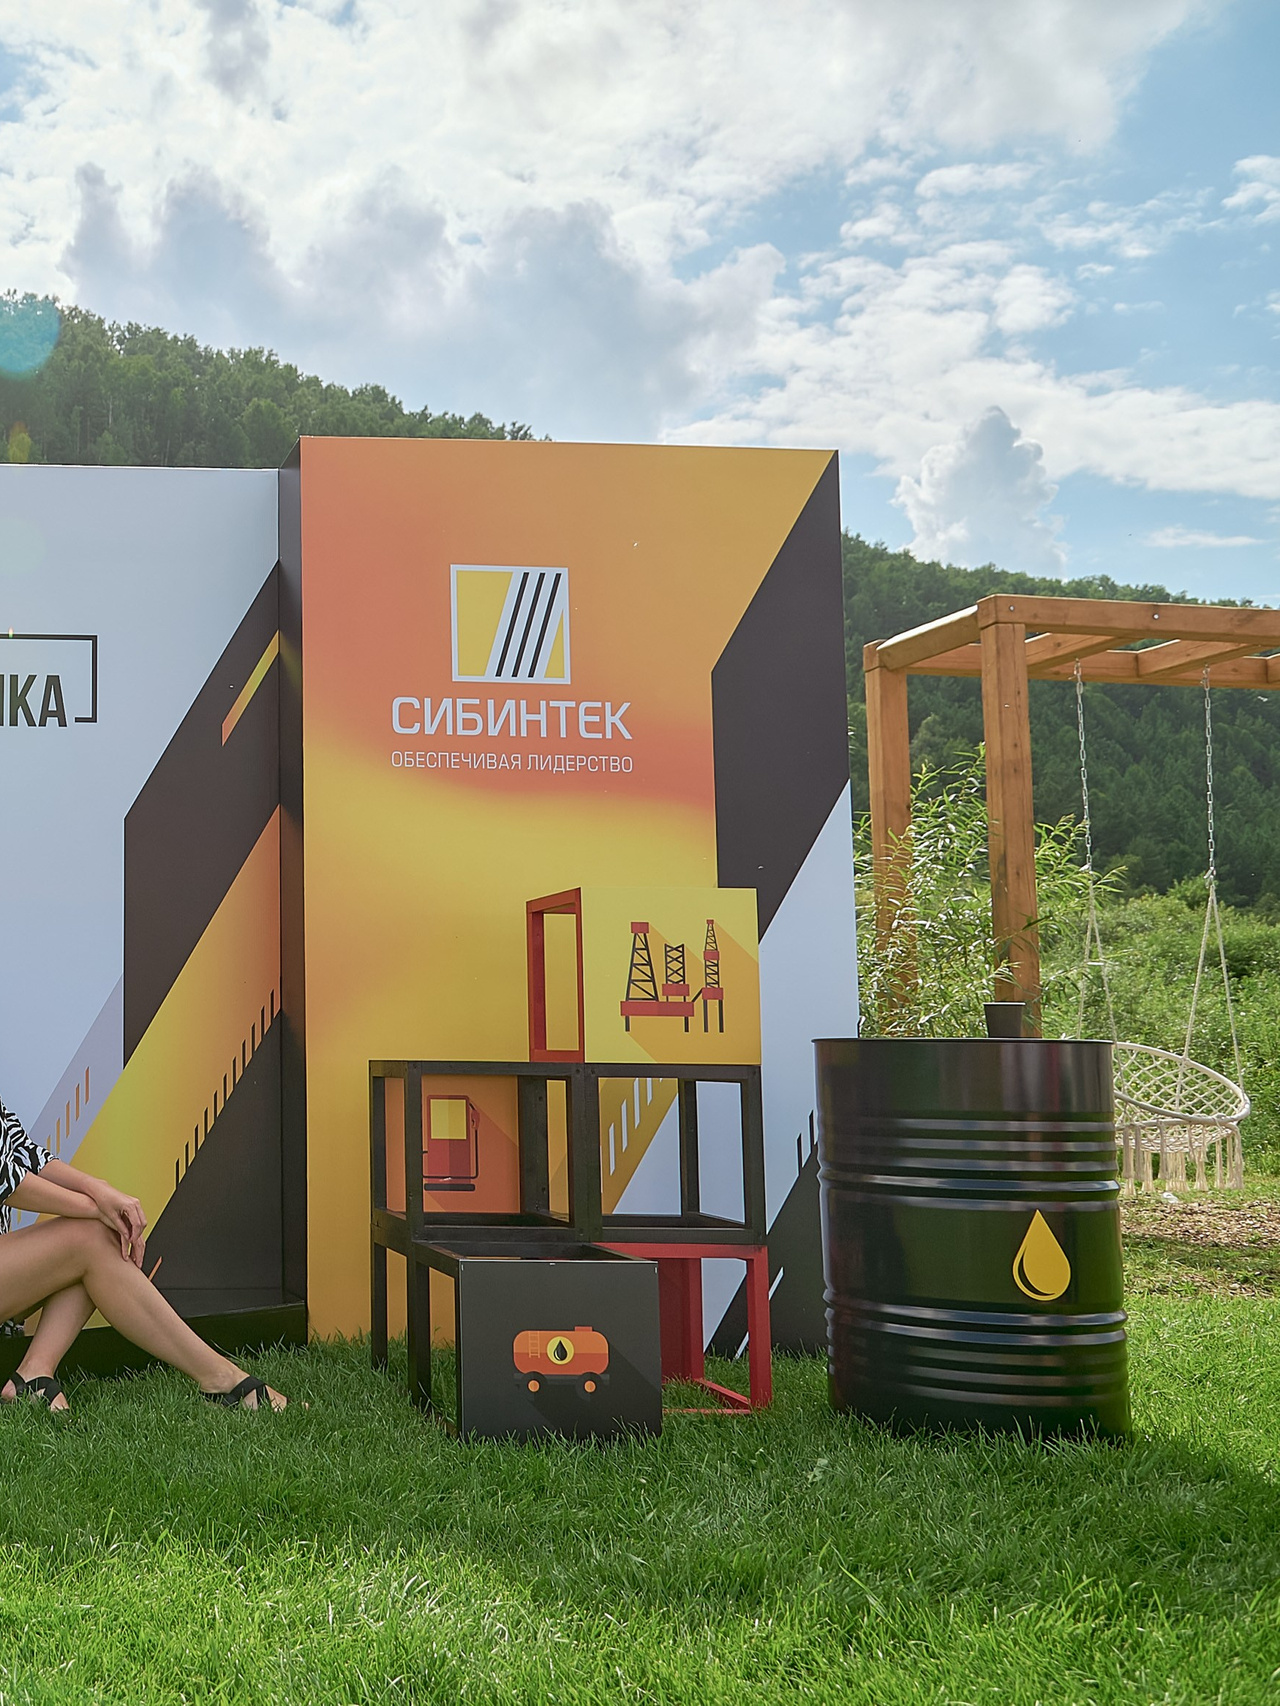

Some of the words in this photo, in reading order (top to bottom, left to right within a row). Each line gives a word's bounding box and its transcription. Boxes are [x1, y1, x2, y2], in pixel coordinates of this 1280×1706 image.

[391, 696, 633, 740] СИБИНТЕК
[391, 750, 521, 770] ОБЕСПЕЧИВАЯ
[527, 754, 633, 774] ЛИДЕРСТВО
